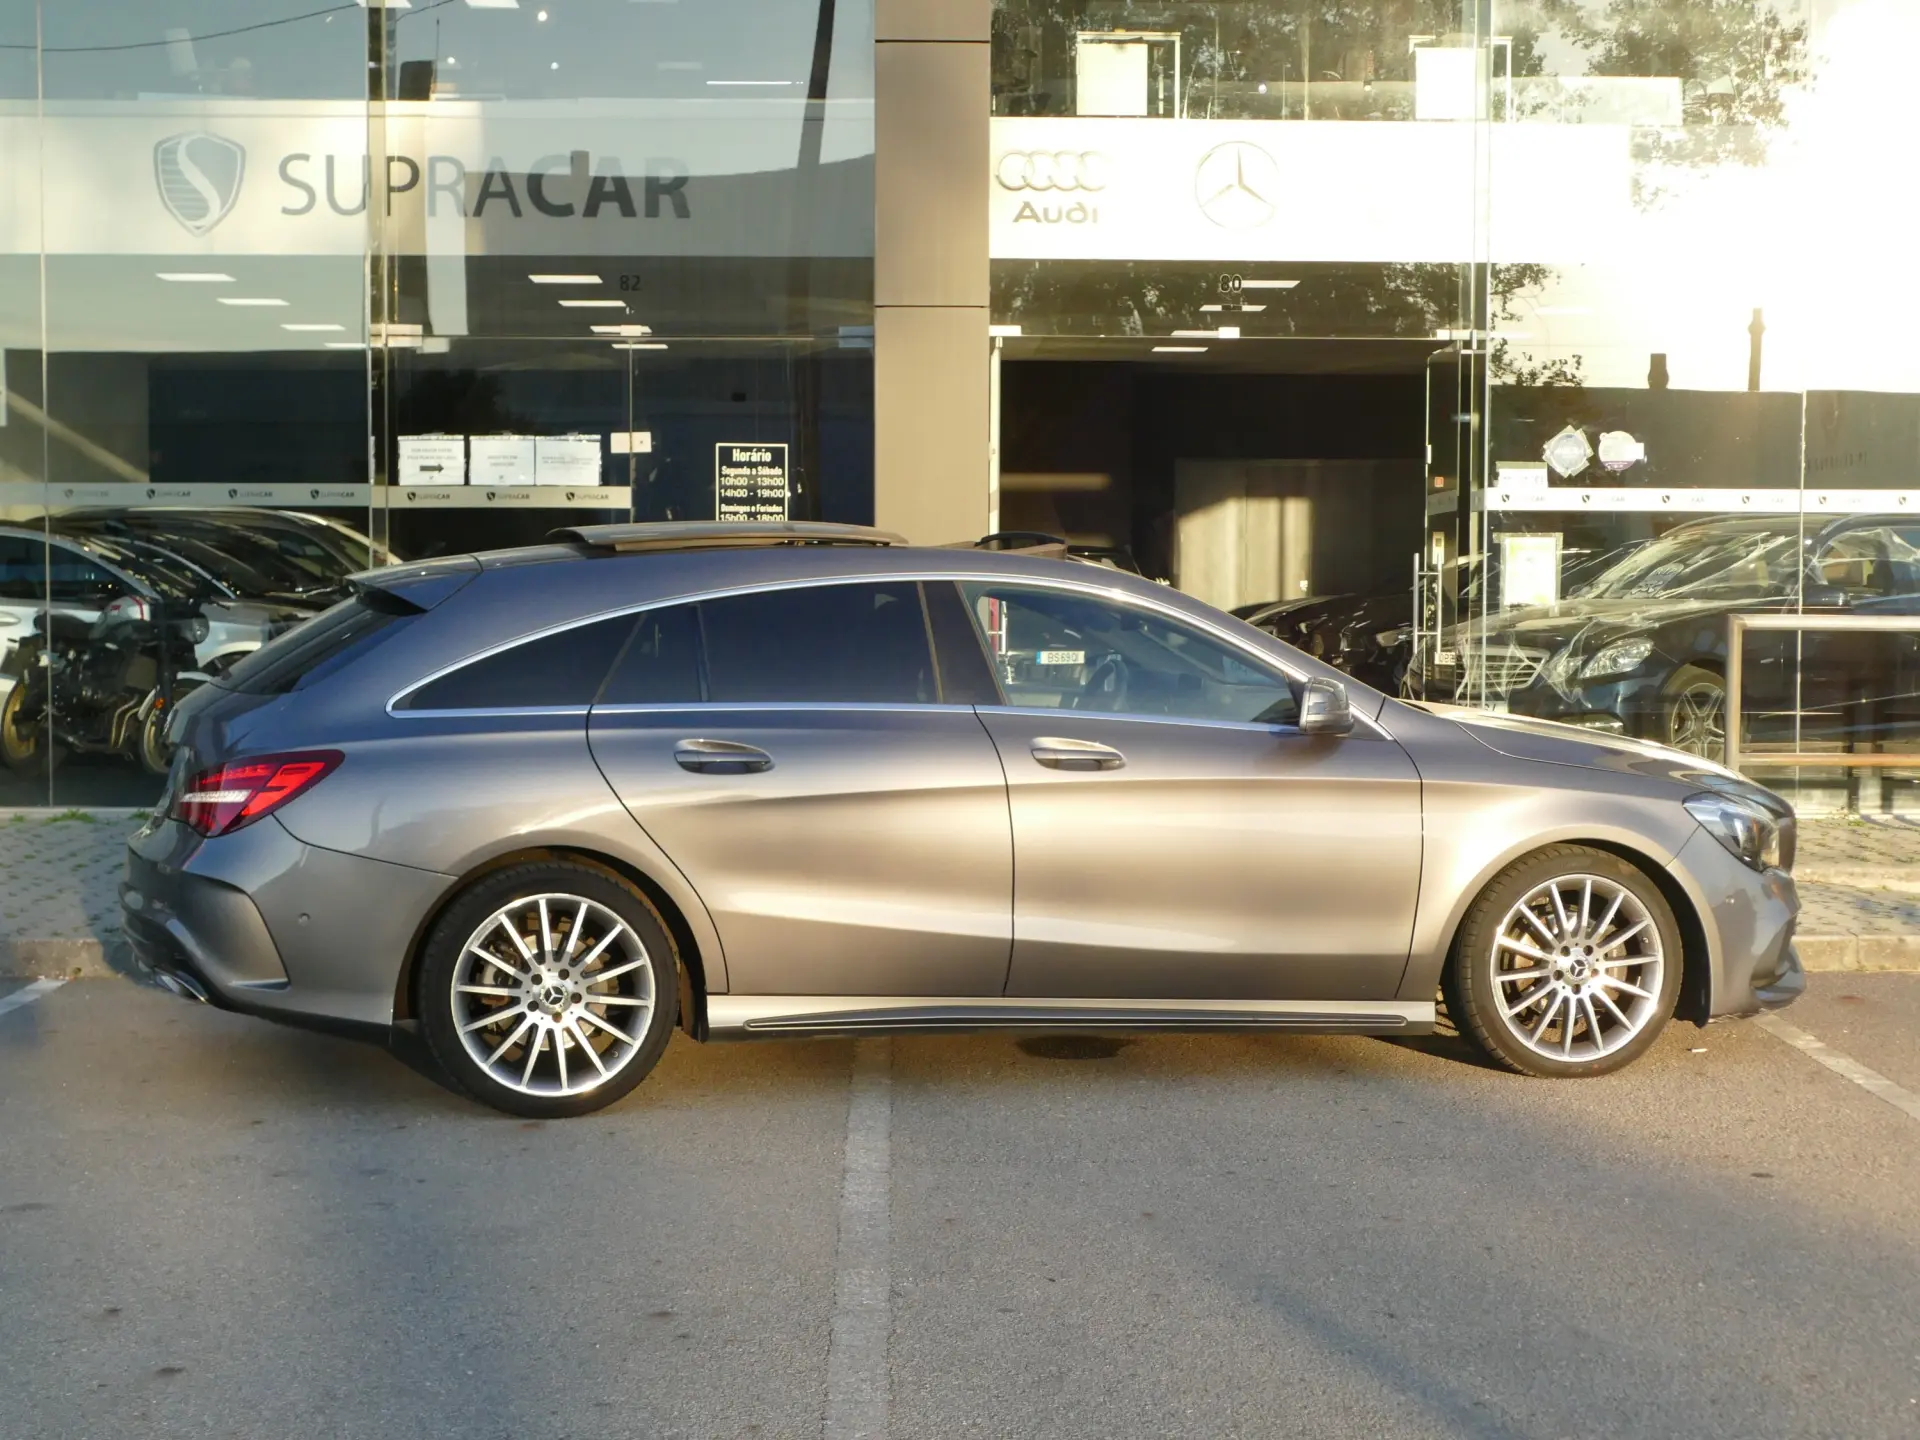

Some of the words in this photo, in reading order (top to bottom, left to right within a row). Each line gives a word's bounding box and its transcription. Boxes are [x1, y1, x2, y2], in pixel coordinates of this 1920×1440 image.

[278, 152, 691, 219] SUPRACAR
[1012, 200, 1098, 224] Audi
[619, 274, 642, 291] 82
[1219, 273, 1243, 293] 80
[732, 448, 772, 462] Horário
[721, 466, 750, 476] Segunda
[757, 466, 782, 475] Sábado
[720, 477, 748, 486] 10h00
[757, 477, 784, 486] 13h00
[720, 489, 748, 498] 14h00
[757, 489, 784, 498] 19h00
